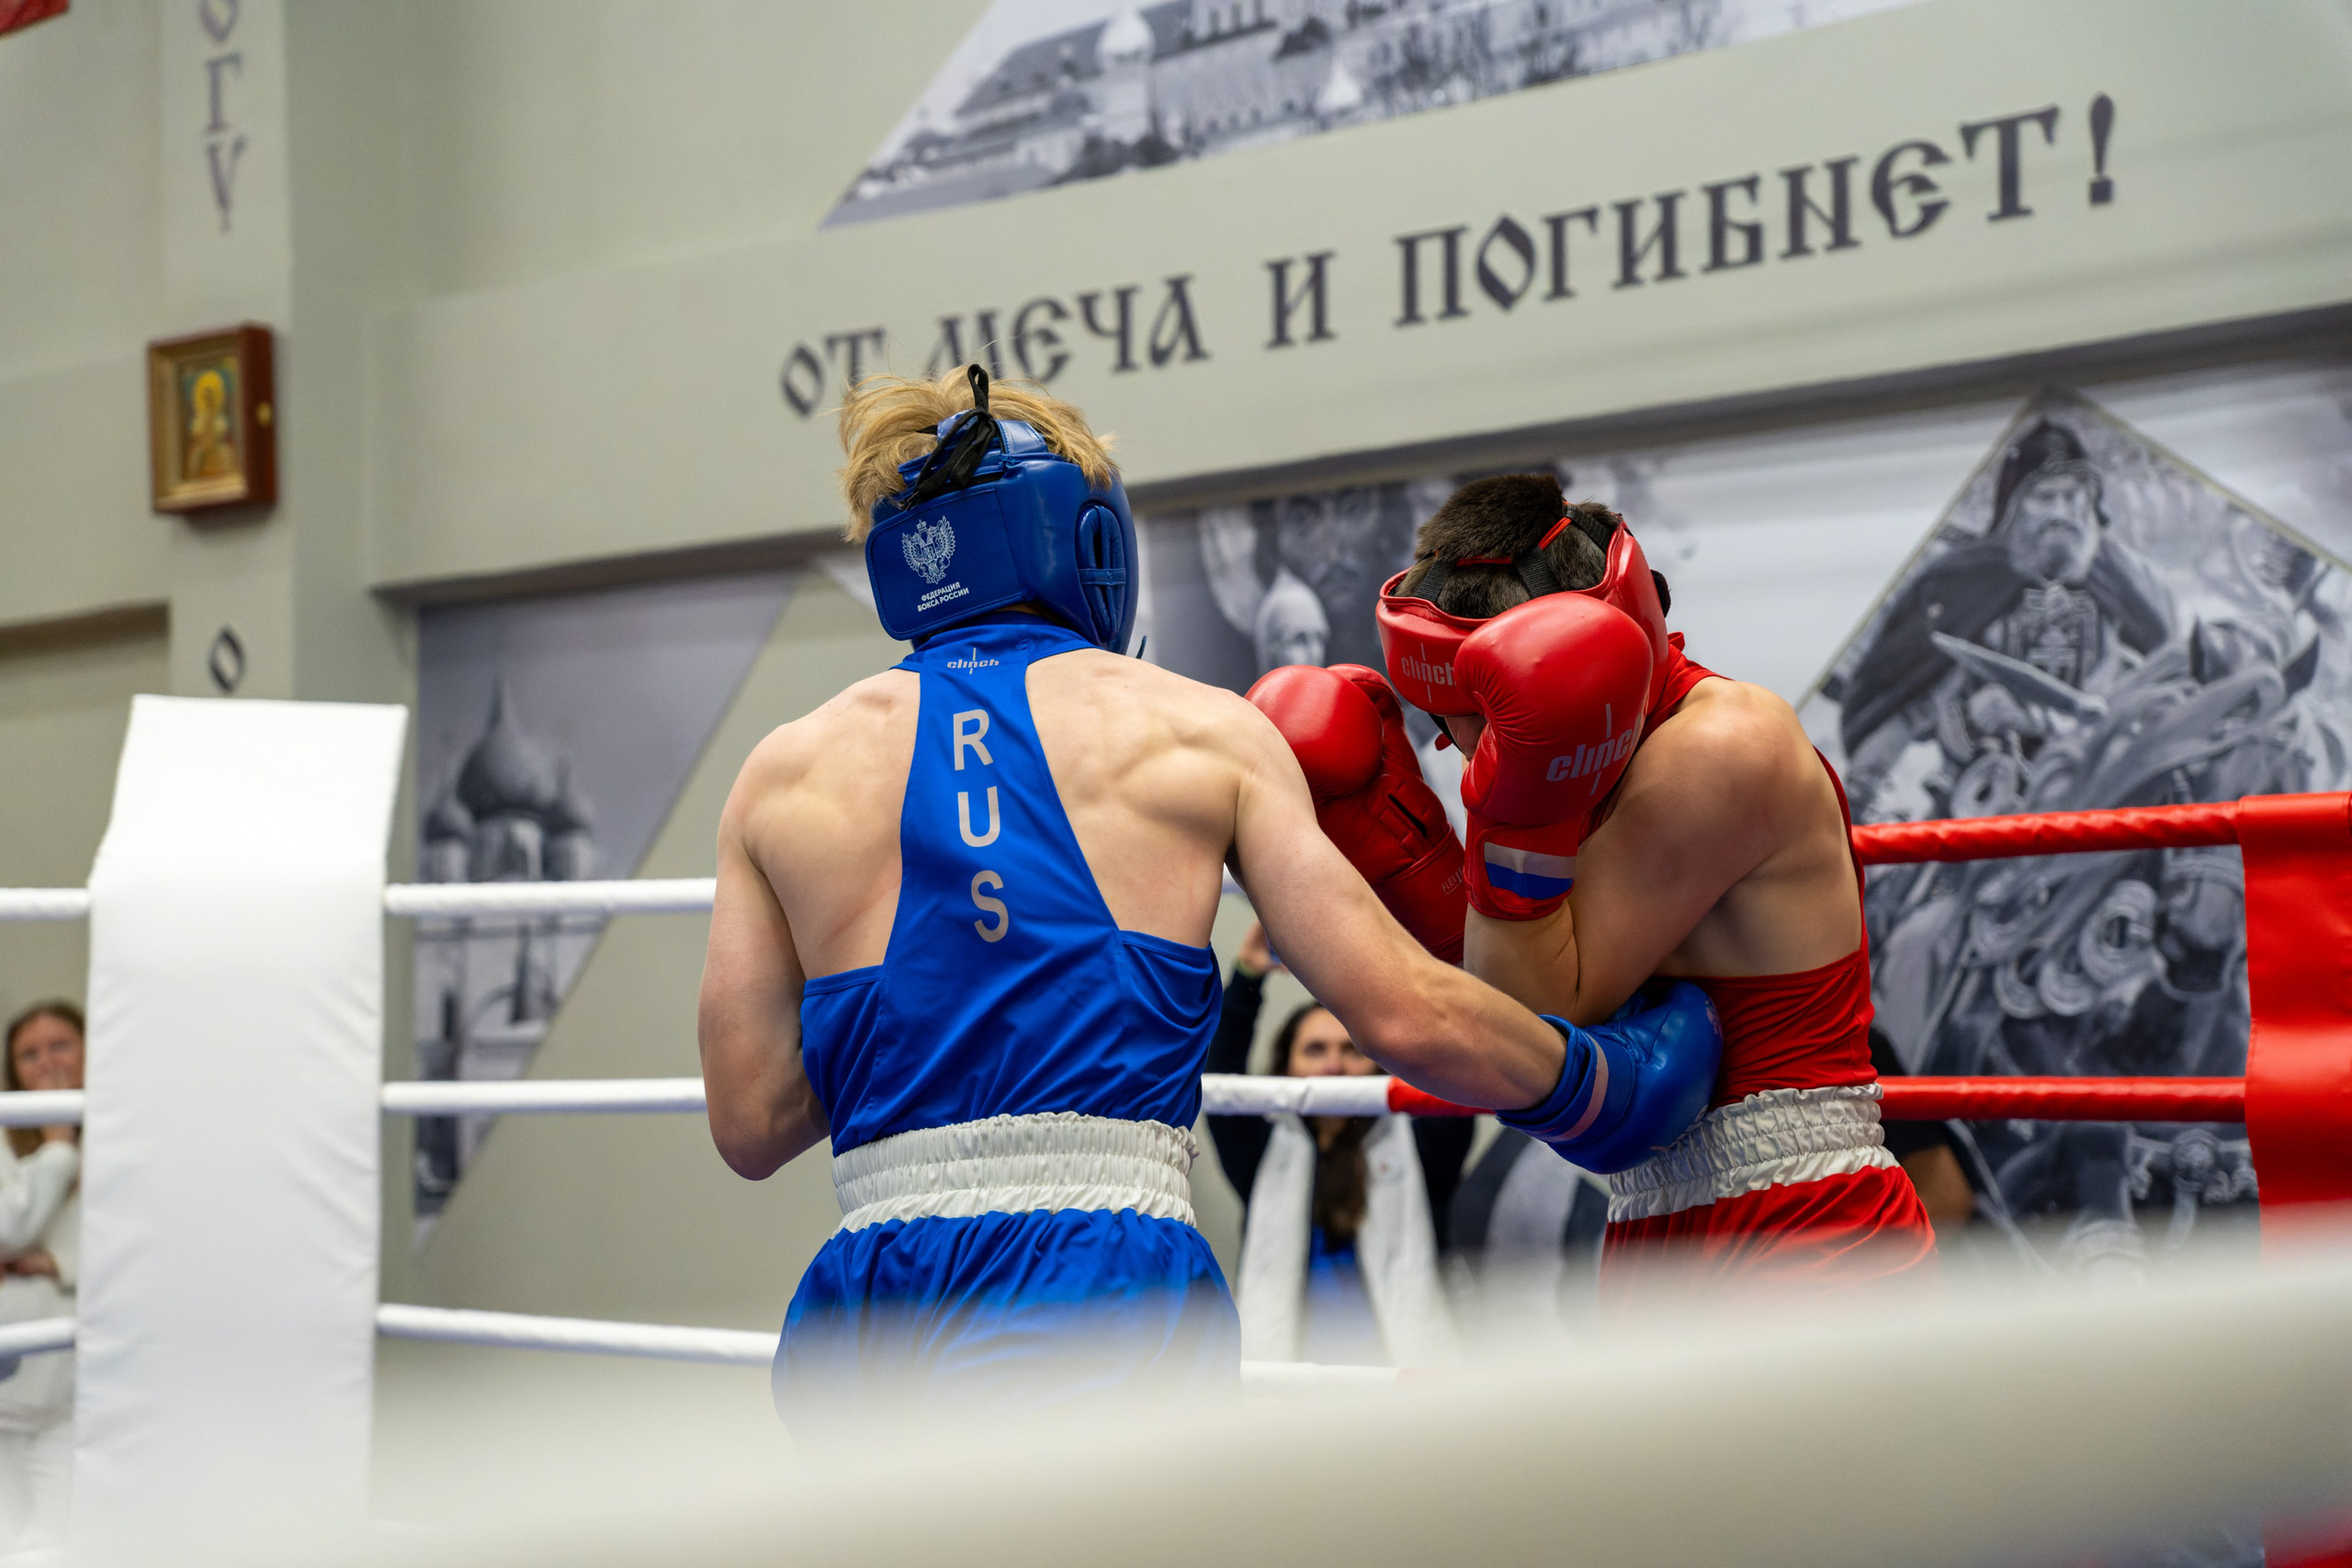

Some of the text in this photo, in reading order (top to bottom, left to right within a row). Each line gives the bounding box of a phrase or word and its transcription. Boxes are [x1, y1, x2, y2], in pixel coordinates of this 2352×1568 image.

[779, 324, 886, 419] ОТ
[1262, 249, 1338, 351] И
[917, 587, 970, 612] БОКСА РОССИИ
[921, 581, 961, 602] ФЕДЕРАЦИЯ
[946, 655, 1000, 671] clinch
